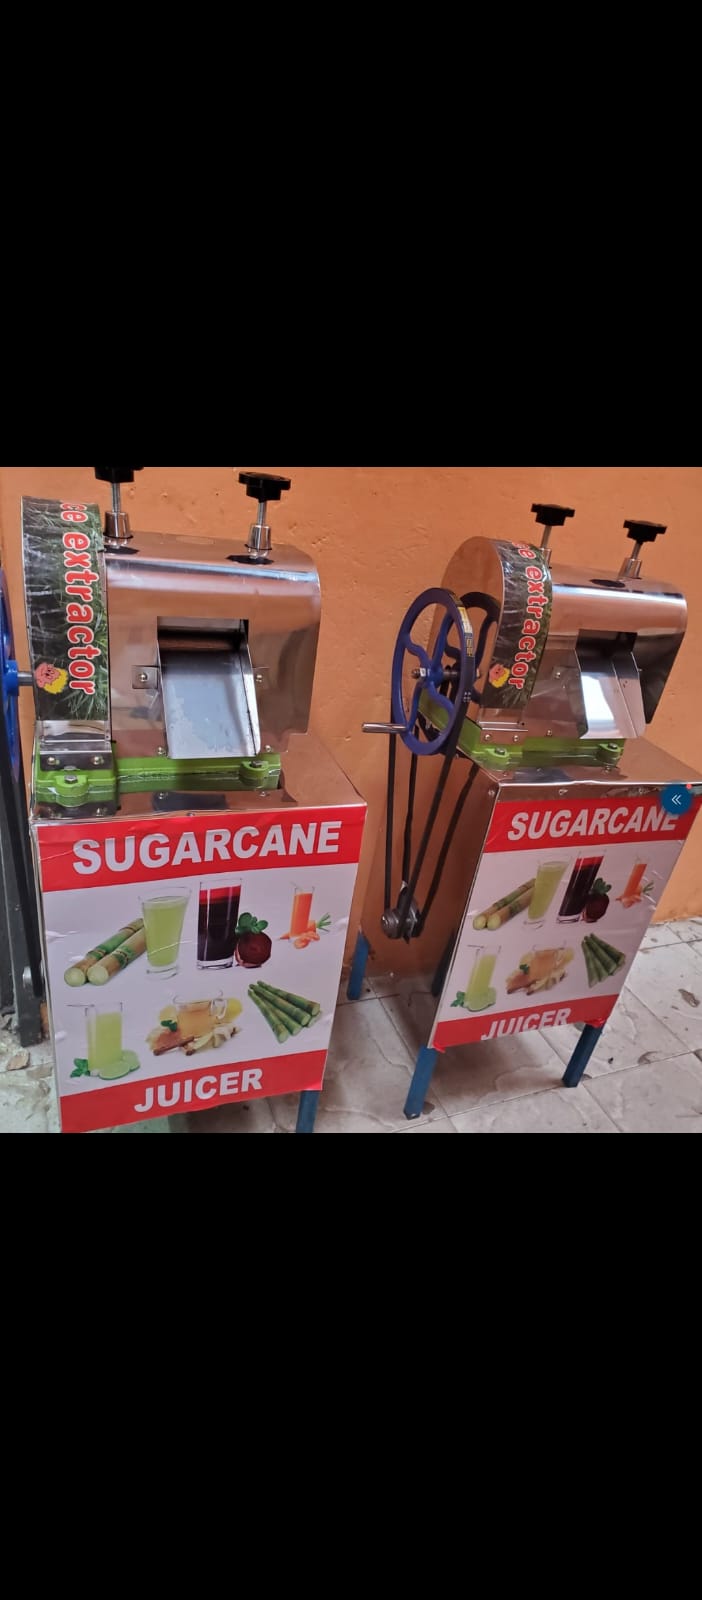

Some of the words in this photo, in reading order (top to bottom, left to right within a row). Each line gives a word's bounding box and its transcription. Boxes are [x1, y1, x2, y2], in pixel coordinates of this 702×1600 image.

[63, 532, 101, 695] extractor
[508, 566, 548, 690] extractor
[72, 821, 342, 875] SUGARCANE
[508, 806, 679, 841] SUGARCANE
[481, 1008, 571, 1040] JUICER
[134, 1068, 263, 1112] JUICER
